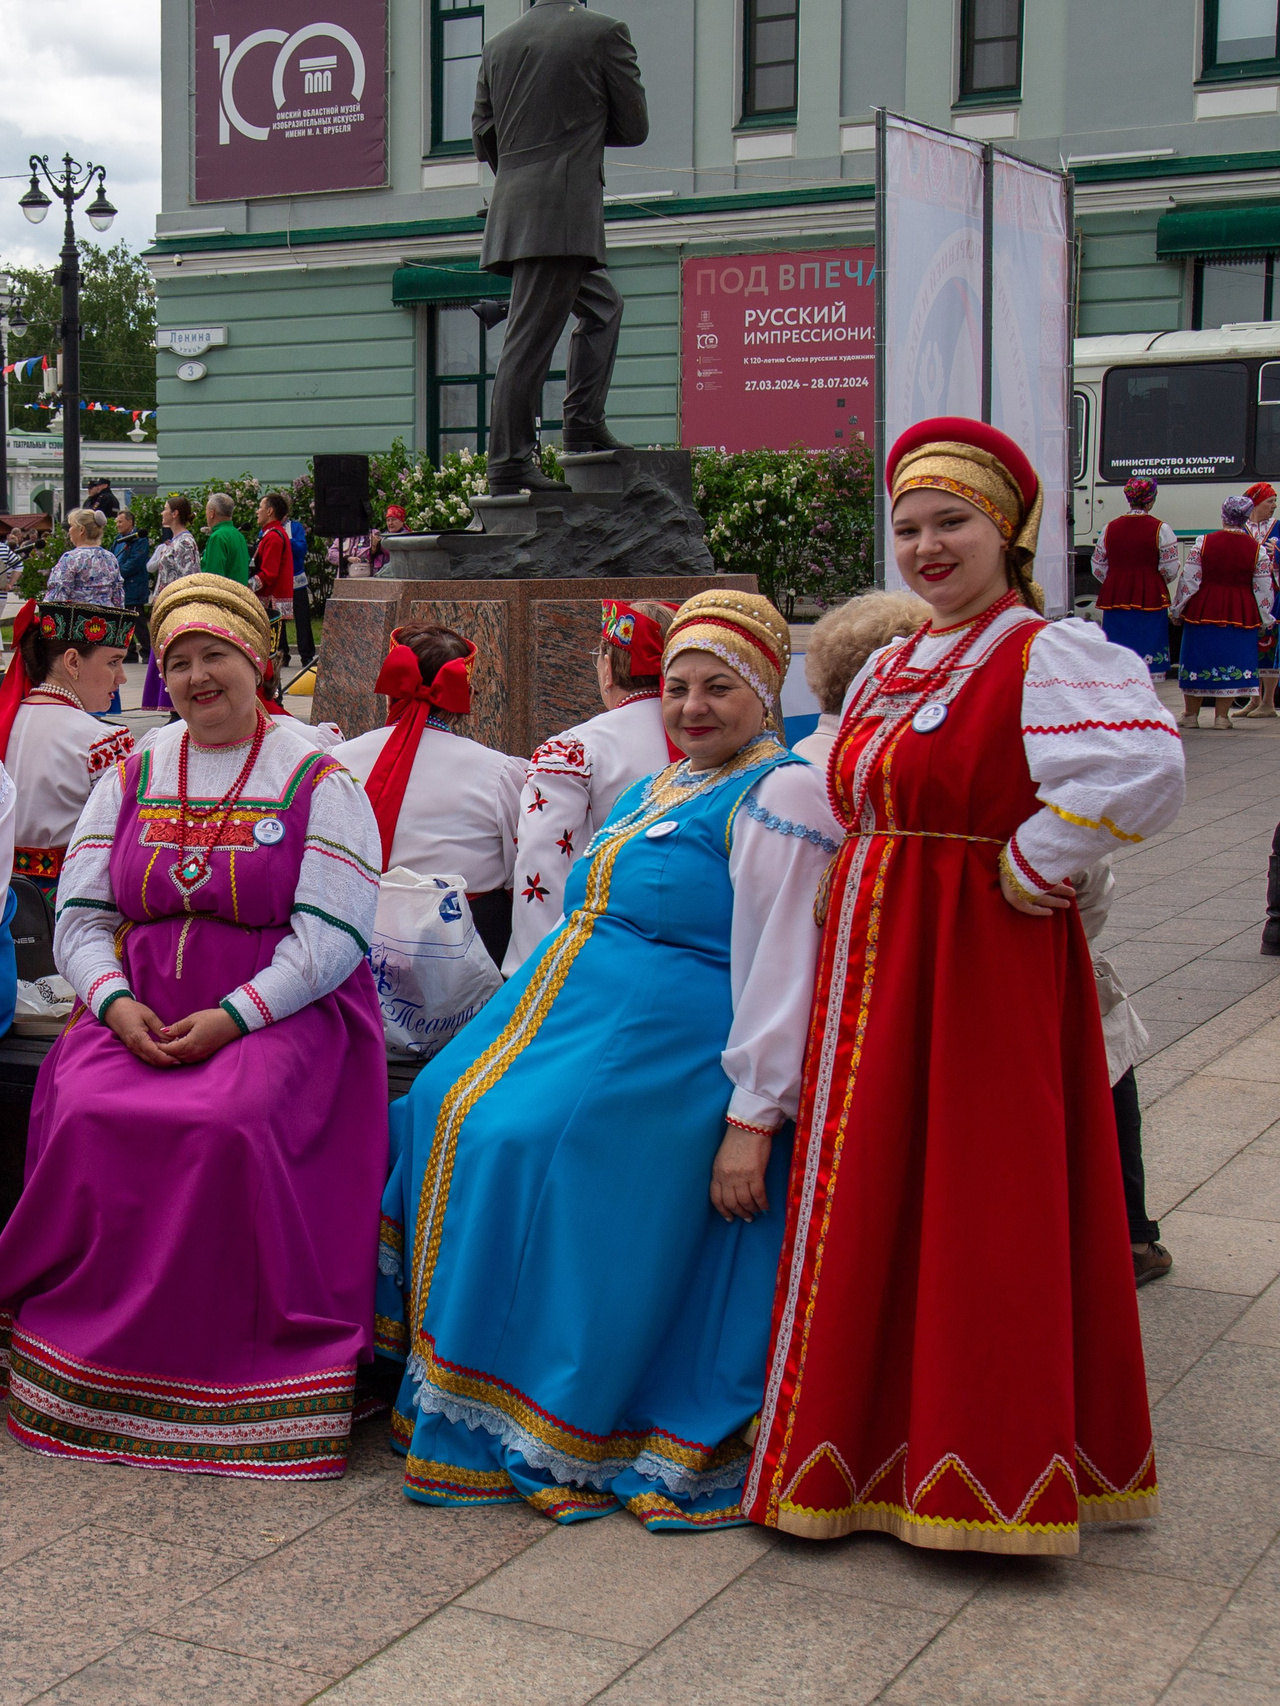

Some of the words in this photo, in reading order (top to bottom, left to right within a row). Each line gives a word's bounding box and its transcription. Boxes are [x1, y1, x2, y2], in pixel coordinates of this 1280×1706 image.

[276, 109, 301, 120] ОМСКИЙ
[302, 105, 339, 117] ОБЛАСТНОЙ
[340, 103, 361, 114] МУЗЕЙ
[272, 116, 332, 130] ИЗОБРАЗИТЕЛЬНЫХ
[332, 113, 365, 125] ИСКУССТВ
[285, 127, 306, 138] ИМЕНИ
[307, 128, 314, 136] М.
[315, 127, 322, 135] А.
[323, 124, 352, 135] ВРУБЕЛЯ
[696, 266, 769, 297] ПОД
[744, 301, 847, 328] РУССКИЙ
[170, 332, 211, 343] Ленина
[743, 357, 749, 365] К
[750, 355, 786, 364] 120-летию
[786, 355, 809, 363] Союза
[809, 355, 838, 363] русских
[838, 353, 875, 362] художник
[187, 365, 194, 377] 3
[744, 380, 801, 391] 27.03.2024
[810, 376, 870, 389] 28.07.2024
[13, 440, 47, 449] ТЕАТРАЛЬНЫЙ
[1111, 457, 1184, 467] МИНИСТЕРСТВО
[1185, 456, 1235, 465] КУЛЬТУРЫ
[1131, 466, 1171, 476] ОМСКОЙ
[1173, 466, 1215, 474] ОБЛАСТИ
